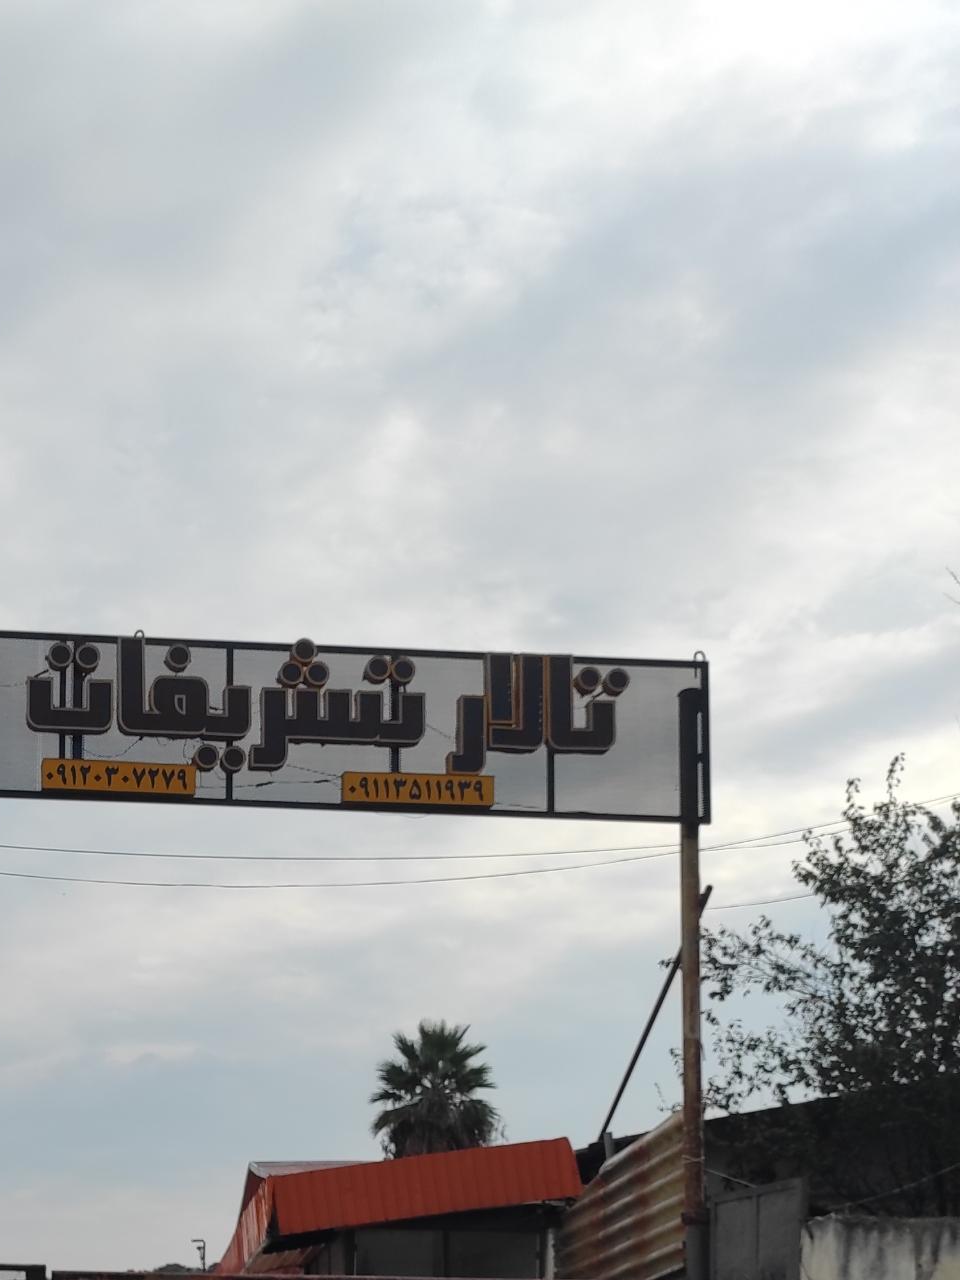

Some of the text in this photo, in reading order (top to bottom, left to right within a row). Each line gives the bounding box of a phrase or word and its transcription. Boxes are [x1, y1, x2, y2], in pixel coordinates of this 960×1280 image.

[26, 637, 426, 773] تشریفات
[445, 652, 630, 775] تالار
[46, 763, 188, 790] ۰۹۱۲۰۳۰۷۲۷۹
[348, 777, 484, 801] ۰۹۱۱۳۵۱۱۹۳۹
